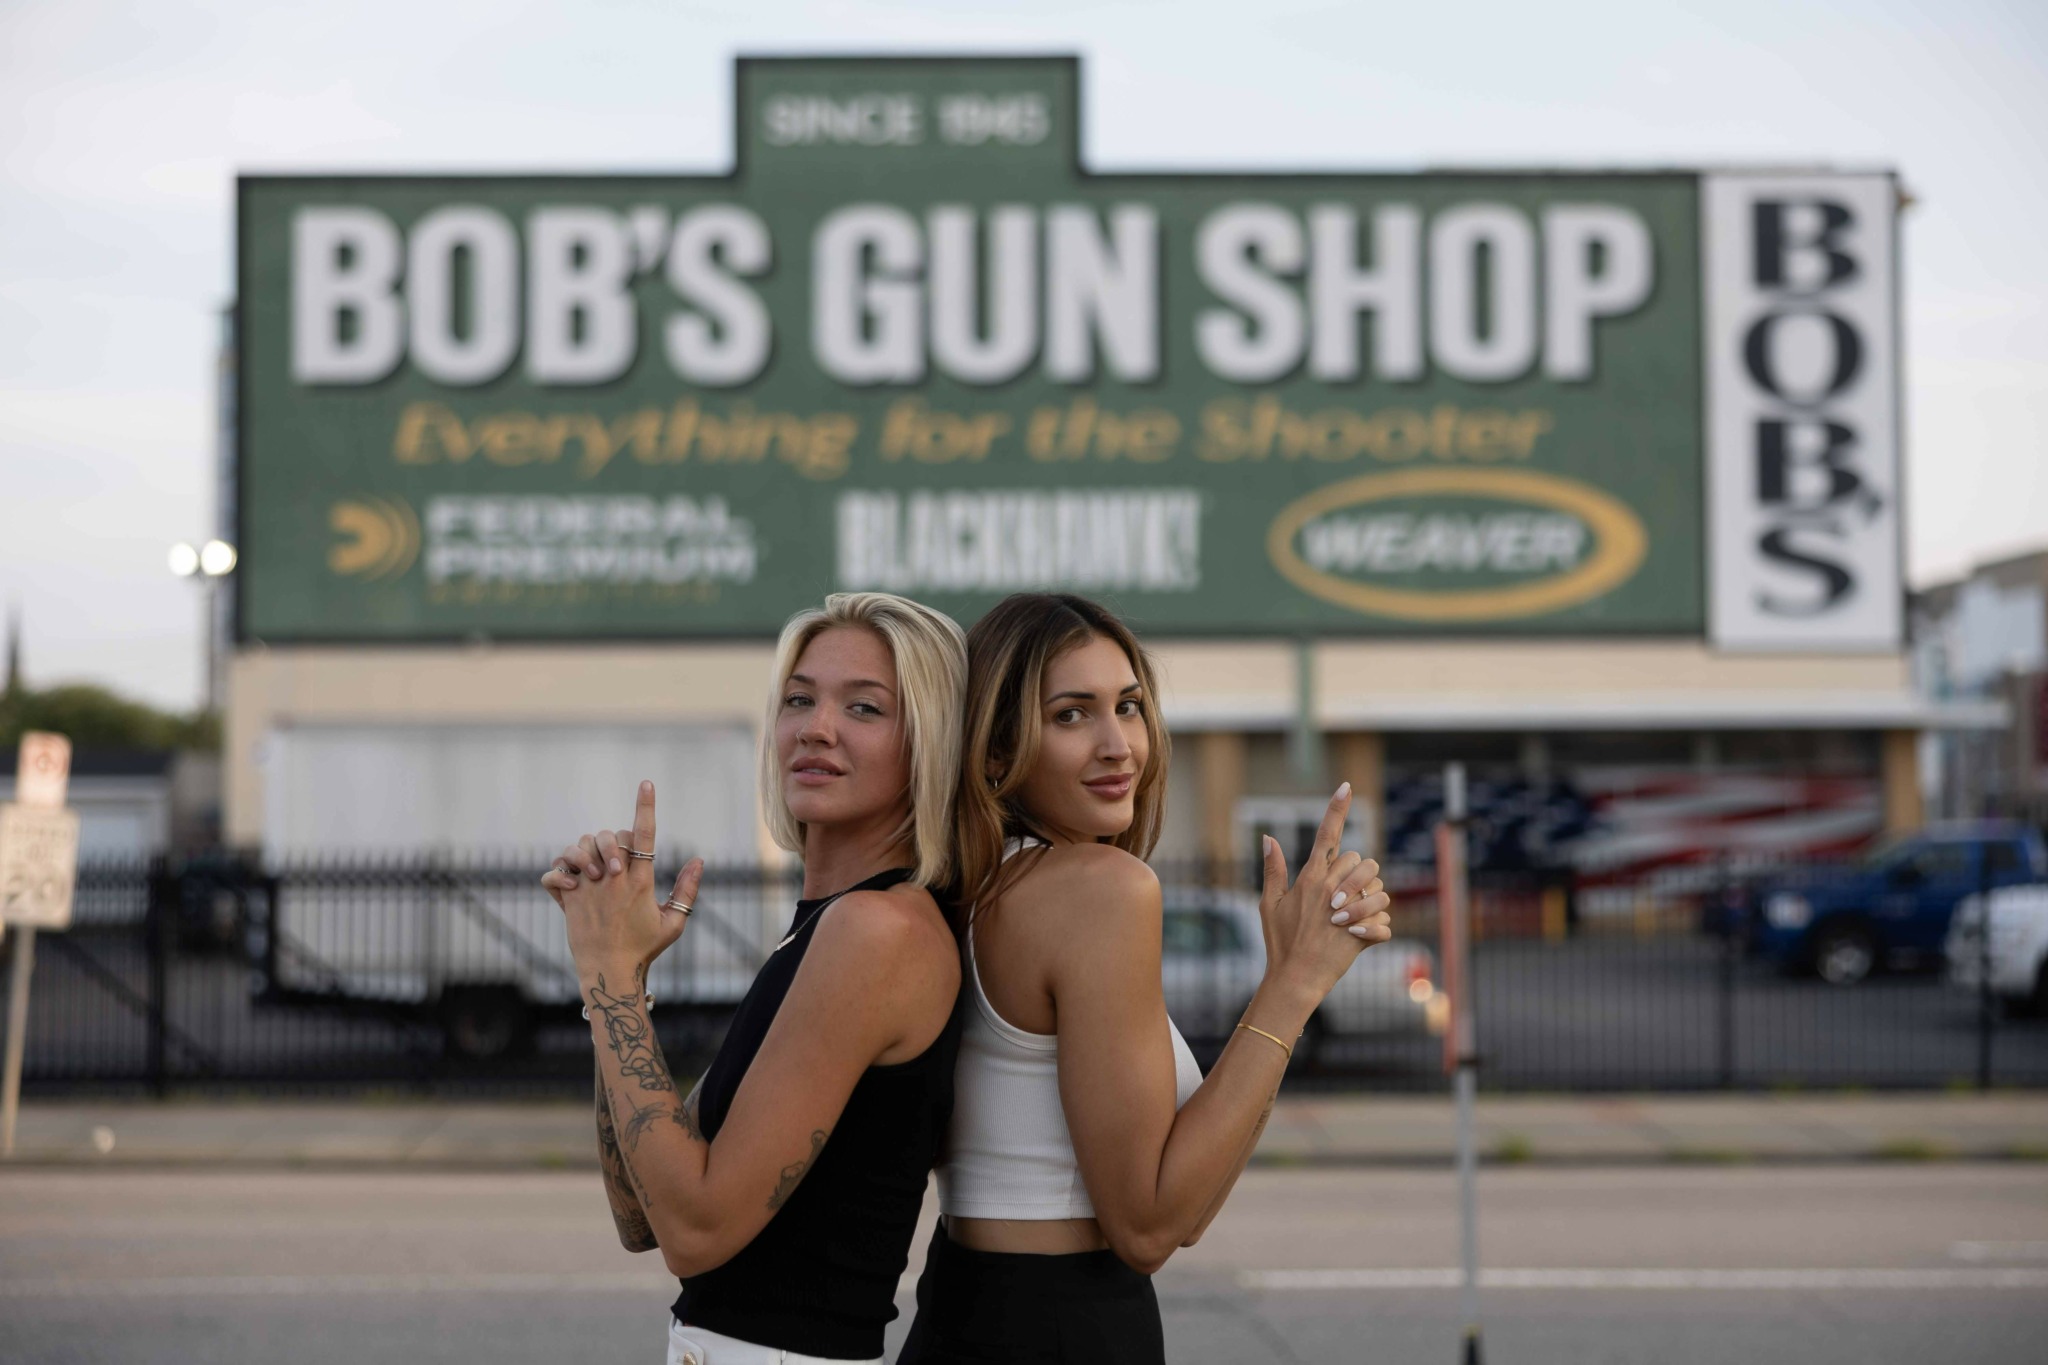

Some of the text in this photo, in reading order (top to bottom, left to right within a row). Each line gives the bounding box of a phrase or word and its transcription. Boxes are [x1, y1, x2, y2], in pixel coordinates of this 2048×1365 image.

[765, 95, 1049, 144] SINCE 1945
[289, 200, 1653, 385] BOB'S GUN SHOP
[394, 399, 858, 478] Everything
[880, 399, 1012, 463] for
[1025, 398, 1181, 463] the
[426, 494, 750, 539] FEDERAL
[1303, 513, 1585, 573] WEAVER
[426, 541, 757, 583] PREMIUM
